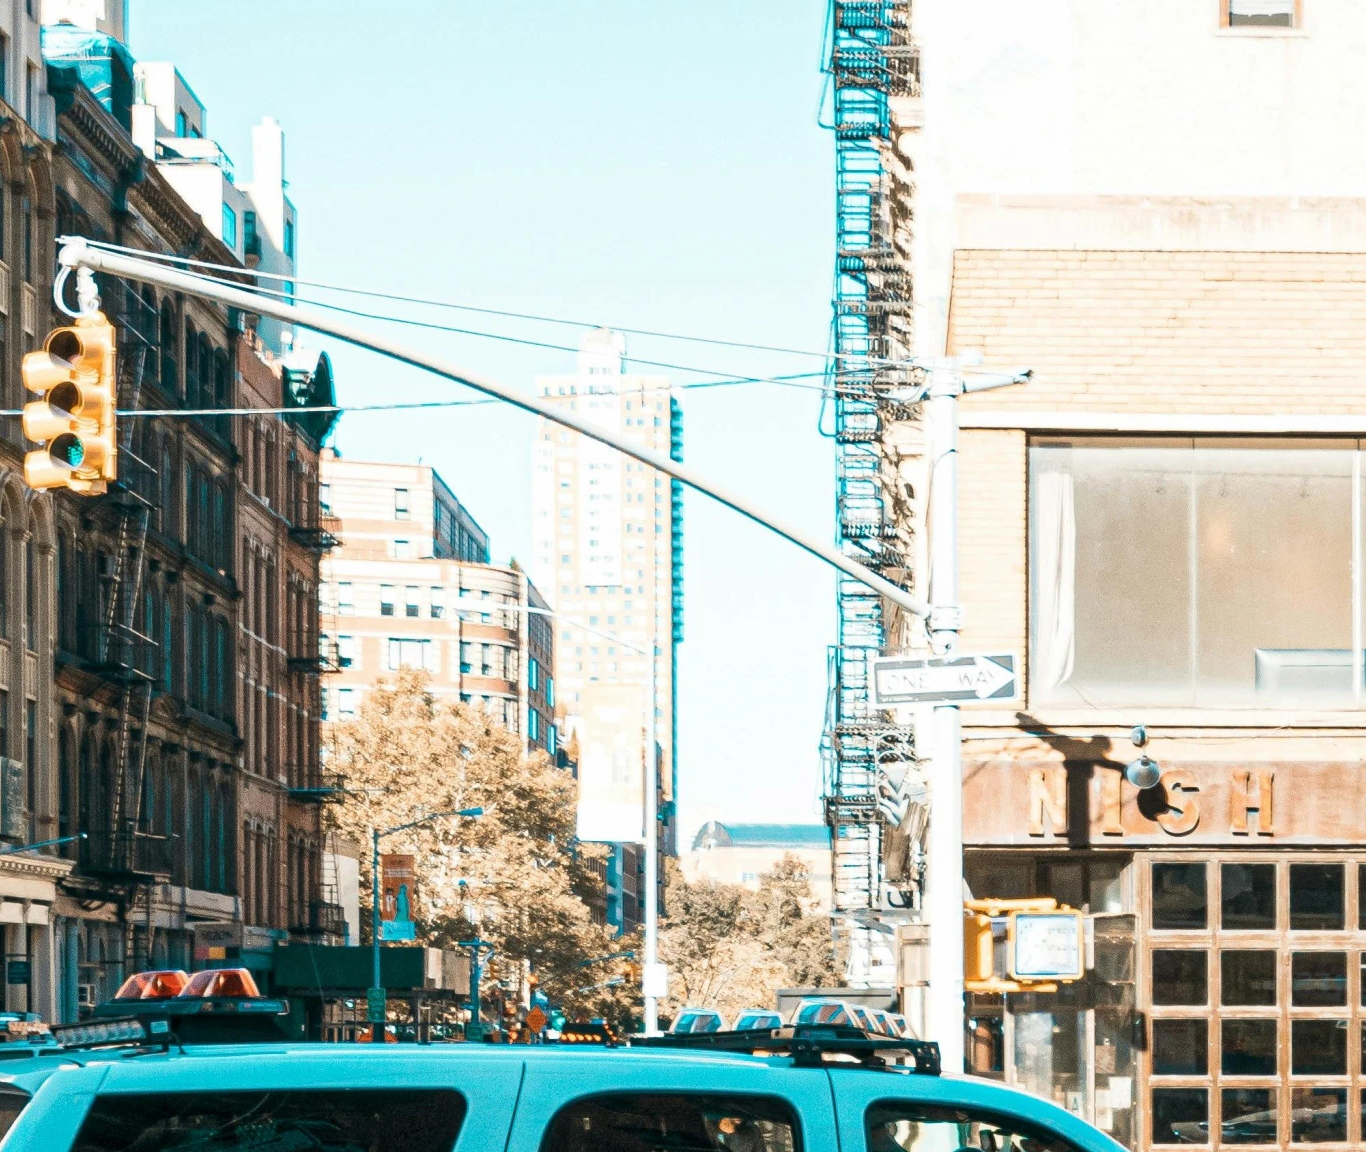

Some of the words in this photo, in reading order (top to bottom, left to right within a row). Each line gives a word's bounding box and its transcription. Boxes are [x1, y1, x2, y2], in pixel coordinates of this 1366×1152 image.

[887, 673, 931, 690] ONE
[959, 670, 999, 687] WAY
[1028, 767, 1275, 837] NISH
